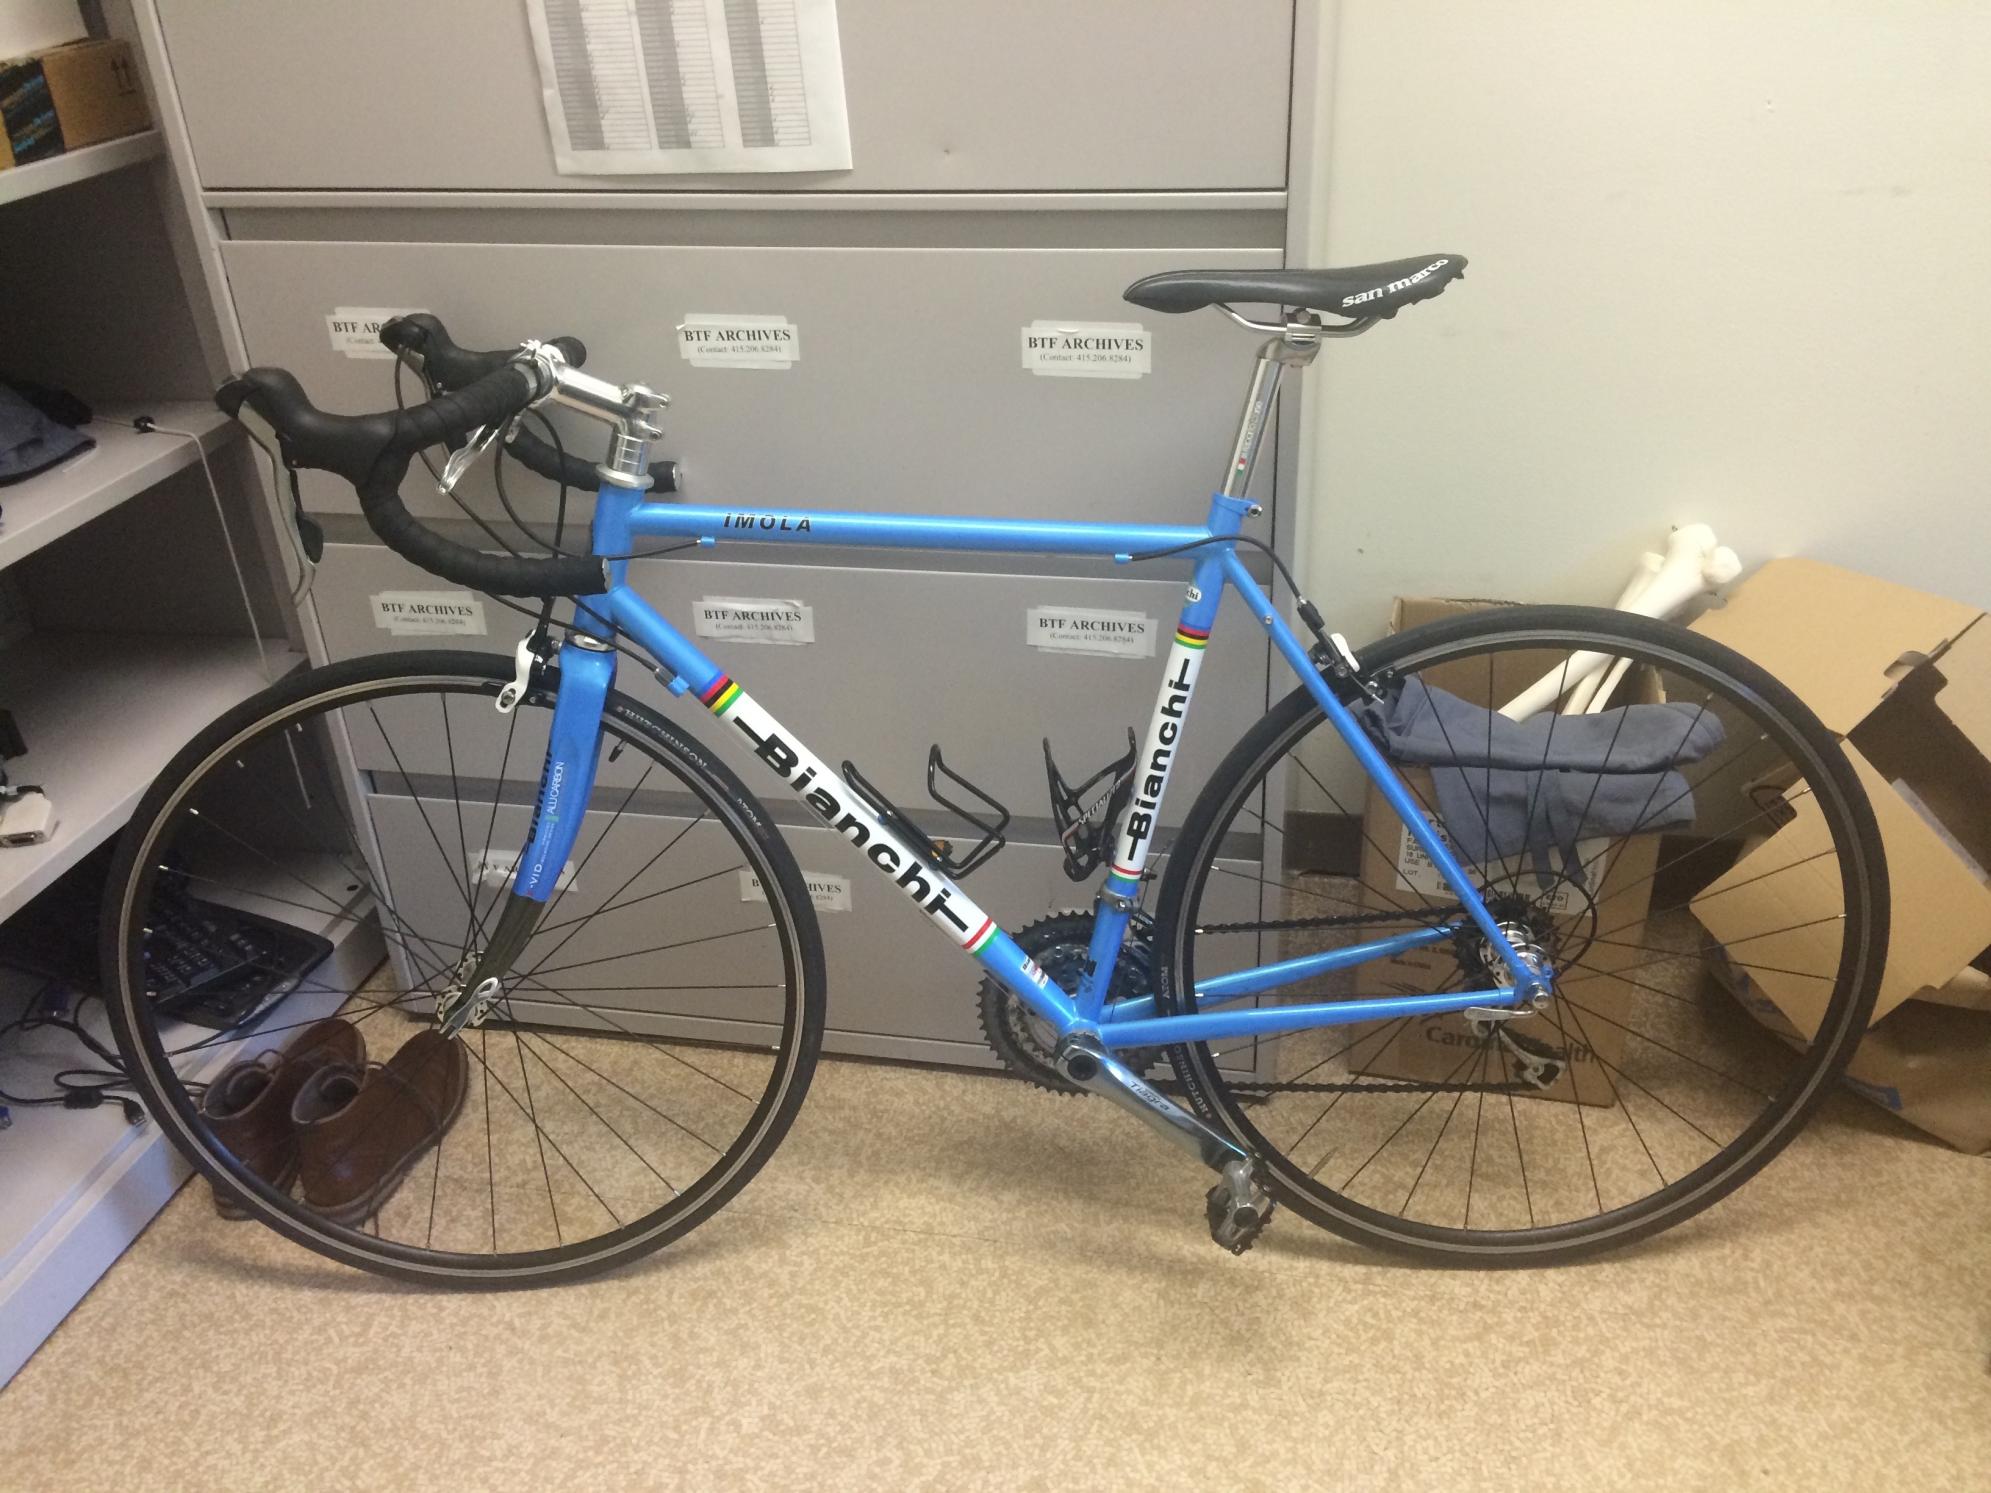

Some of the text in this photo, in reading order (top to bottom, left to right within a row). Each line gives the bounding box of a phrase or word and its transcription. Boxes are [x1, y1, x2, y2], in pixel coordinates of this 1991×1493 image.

[1341, 258, 1449, 308] san marco
[333, 321, 358, 333] BTF
[683, 329, 792, 342] BTF ARCHIVES
[1028, 336, 1144, 351] BTF ARCHIVES
[723, 512, 811, 532] IMOLA
[381, 602, 473, 616] BTF ARCHIVES
[704, 609, 802, 622] BTF ARCHIVES
[1039, 617, 1145, 634] BTF ARCHIVES
[1126, 657, 1191, 861] Bianchi
[732, 716, 969, 933] Bianchi
[1174, 1045, 1209, 1113] HUTCHINSO
